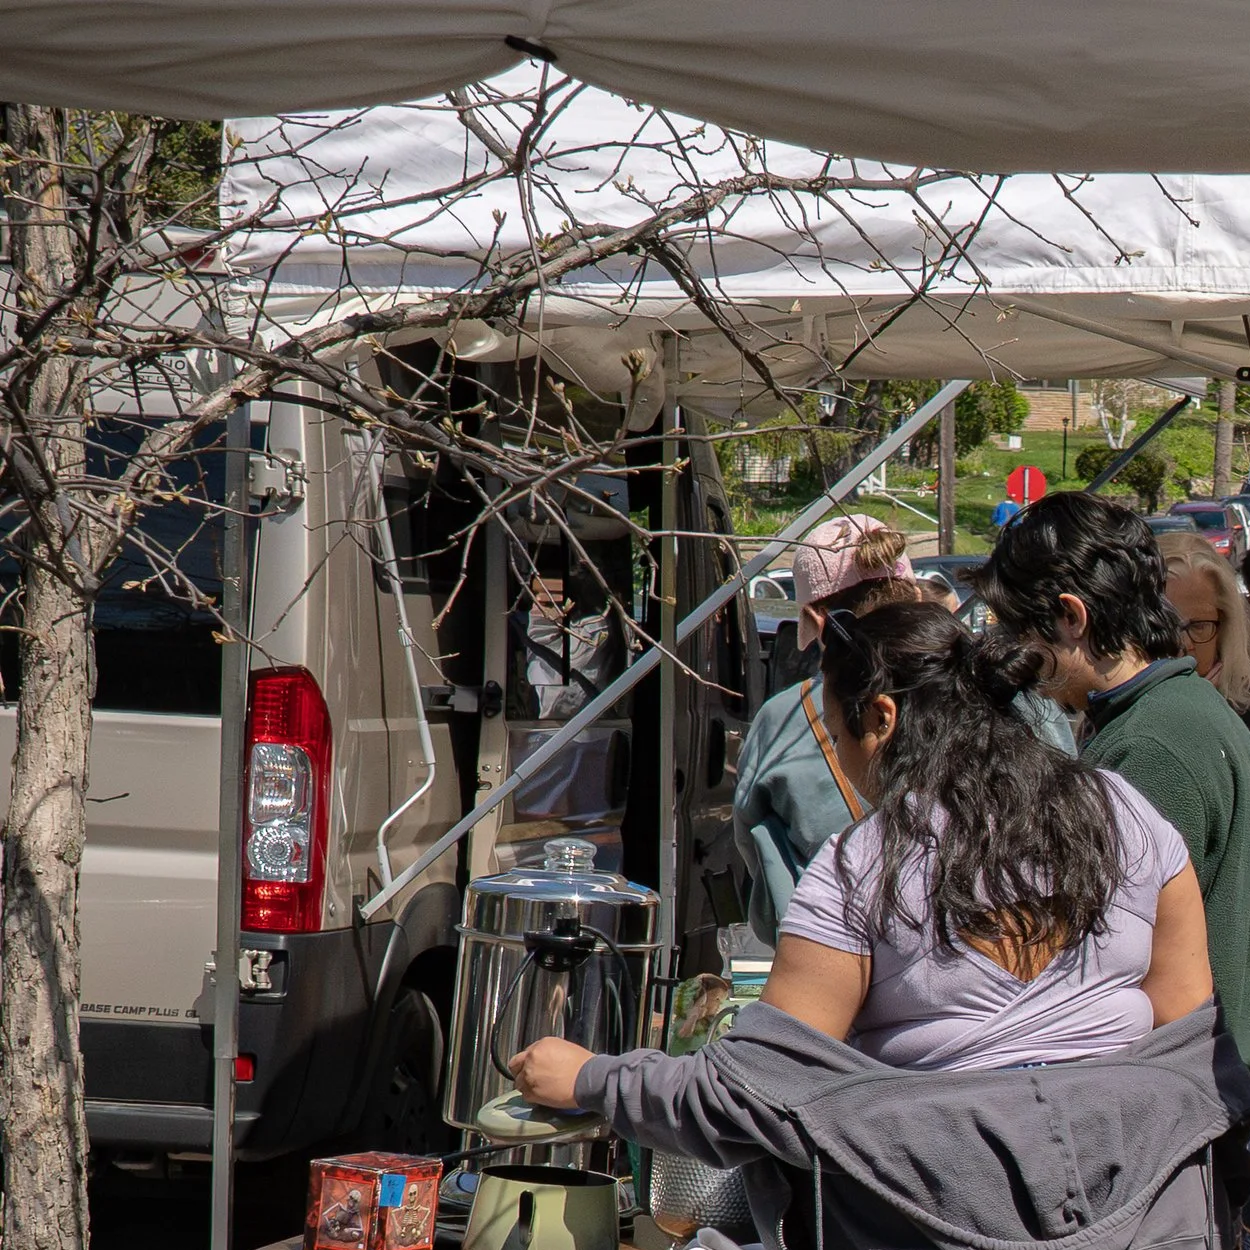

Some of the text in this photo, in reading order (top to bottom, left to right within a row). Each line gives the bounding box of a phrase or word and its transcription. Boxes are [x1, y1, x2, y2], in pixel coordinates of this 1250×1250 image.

[80, 1003, 112, 1014] BASE
[113, 1005, 147, 1016] CAMP
[147, 1007, 180, 1017] PLUS
